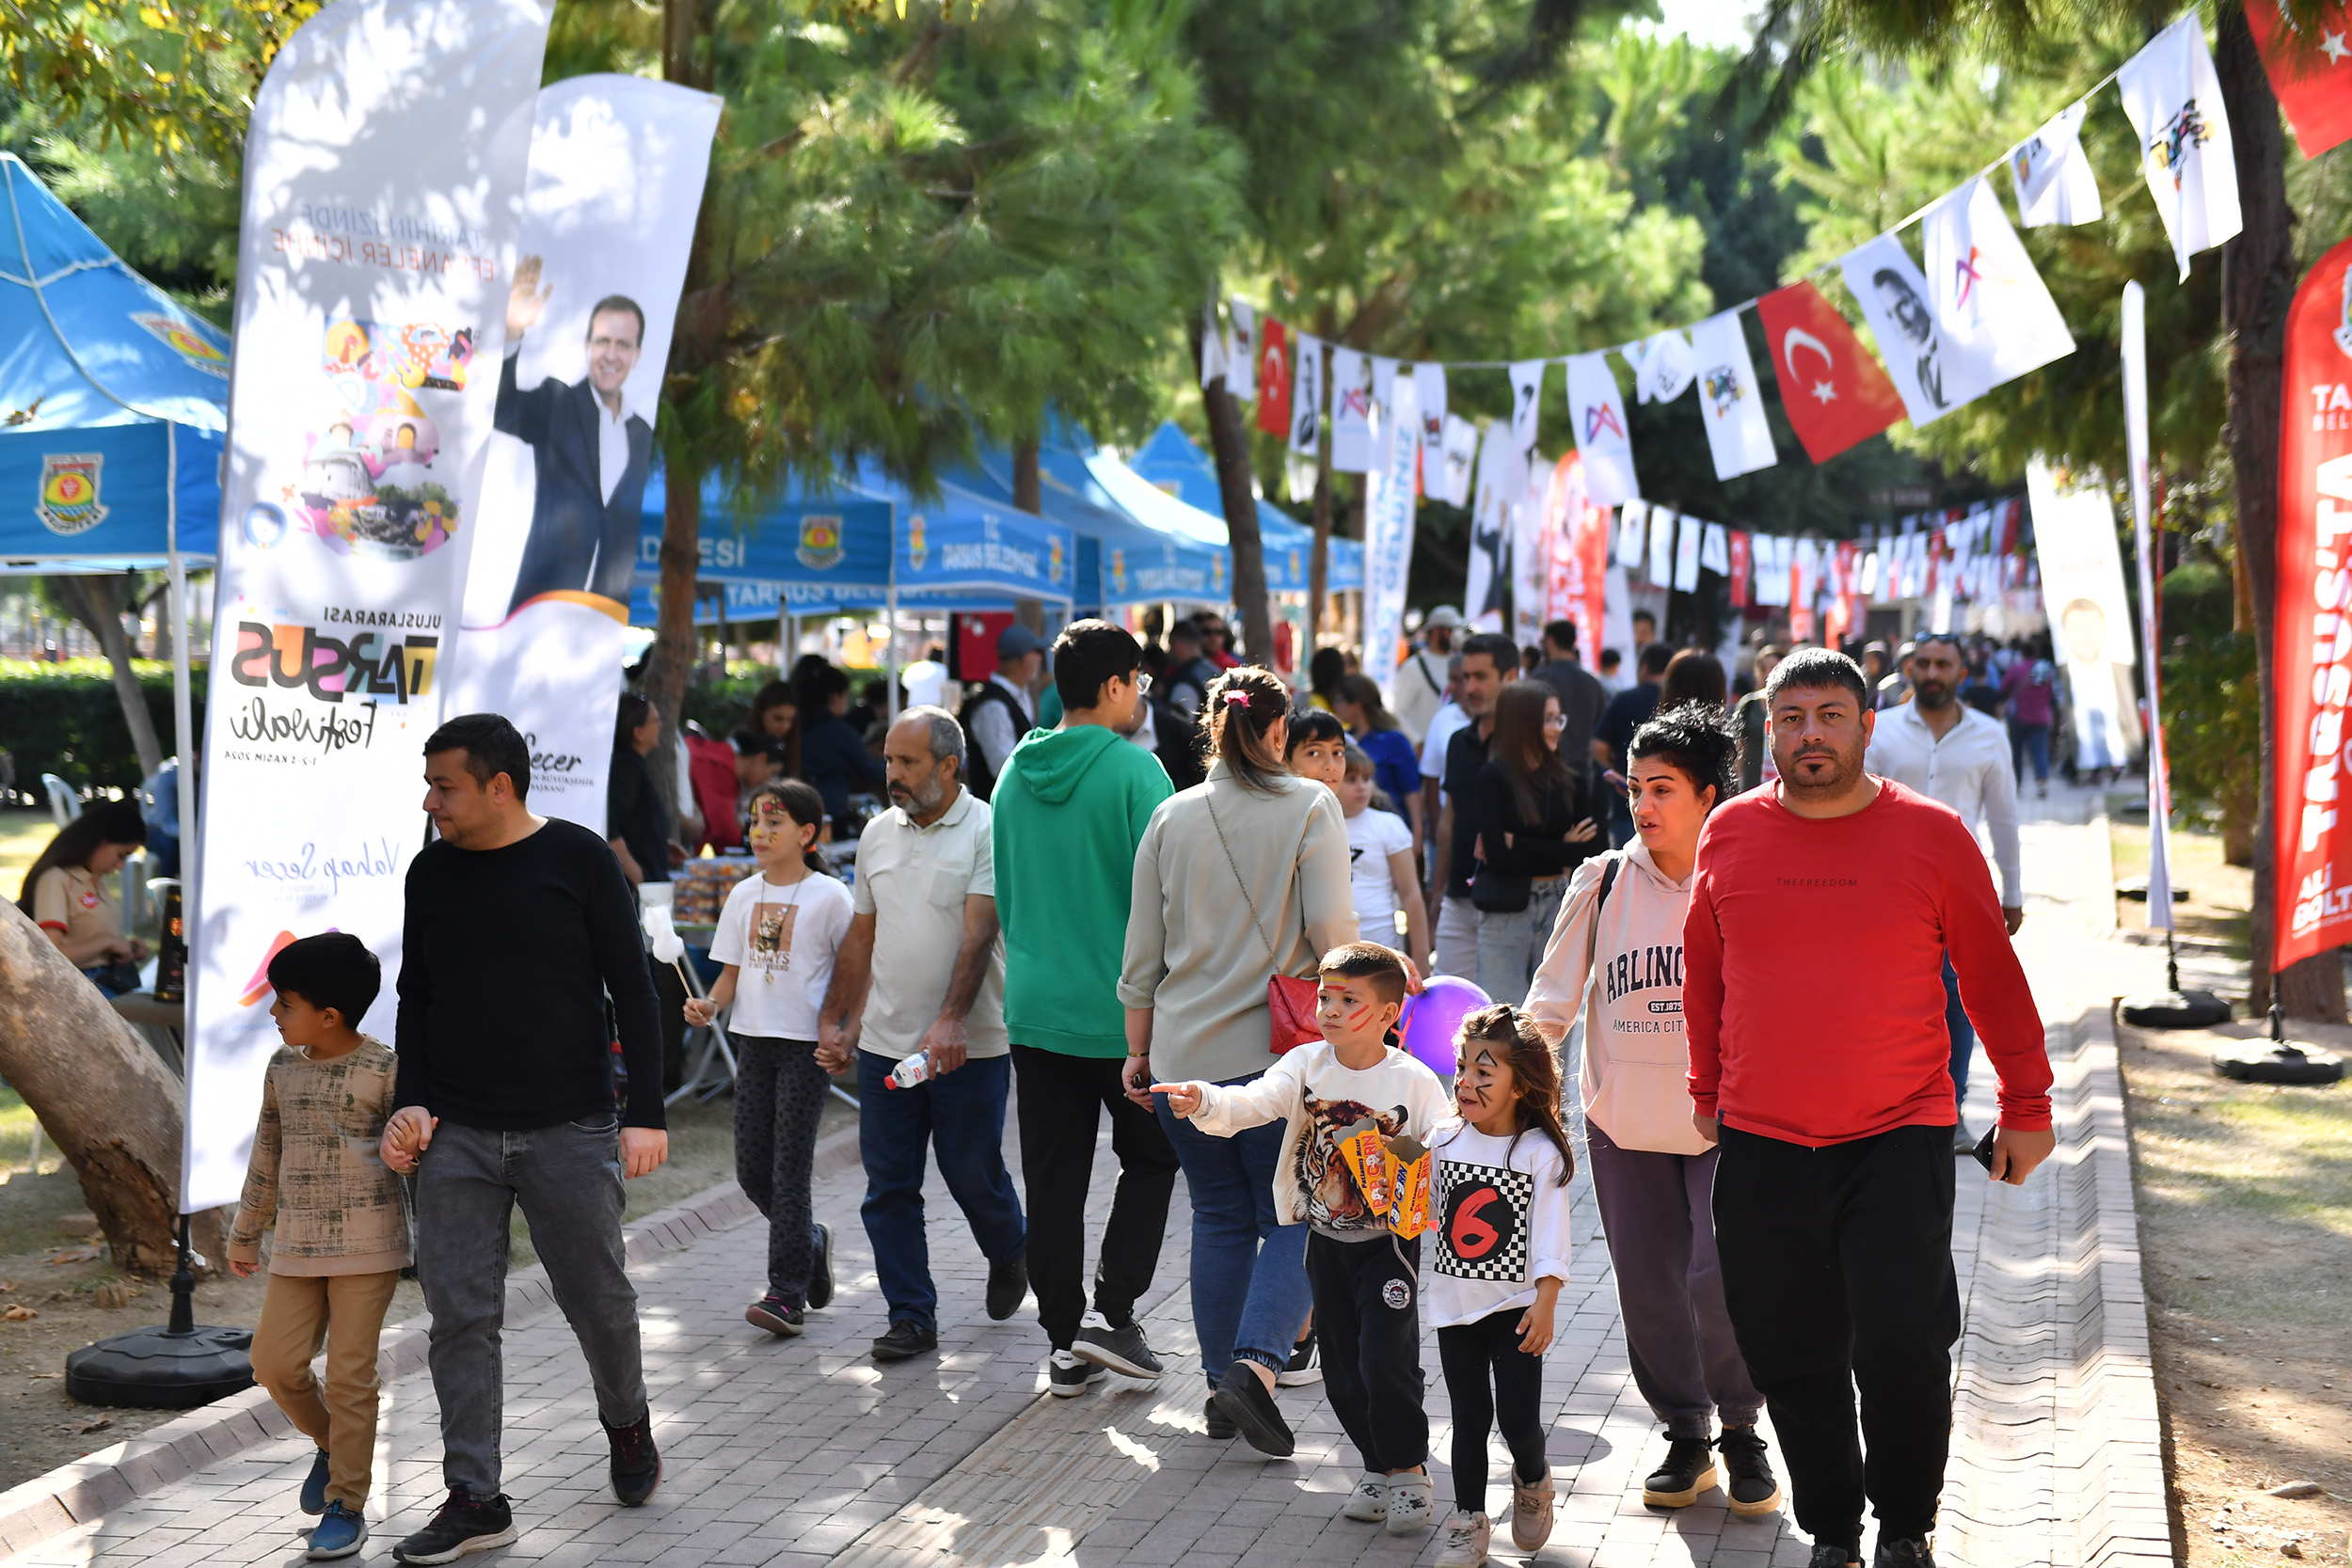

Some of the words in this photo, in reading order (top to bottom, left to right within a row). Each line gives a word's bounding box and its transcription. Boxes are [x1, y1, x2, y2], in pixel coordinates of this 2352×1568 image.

[1776, 878, 1858, 887] THEFREEDOM
[2291, 884, 2352, 931] BOLT
[1613, 1019, 1661, 1033] AMERICA
[1394, 1164, 1408, 1202] CORN
[1410, 1204, 1422, 1233] POP
[1418, 1157, 1430, 1200] CORN
[1390, 1201, 1401, 1229] POP
[1450, 1188, 1500, 1259] 6
